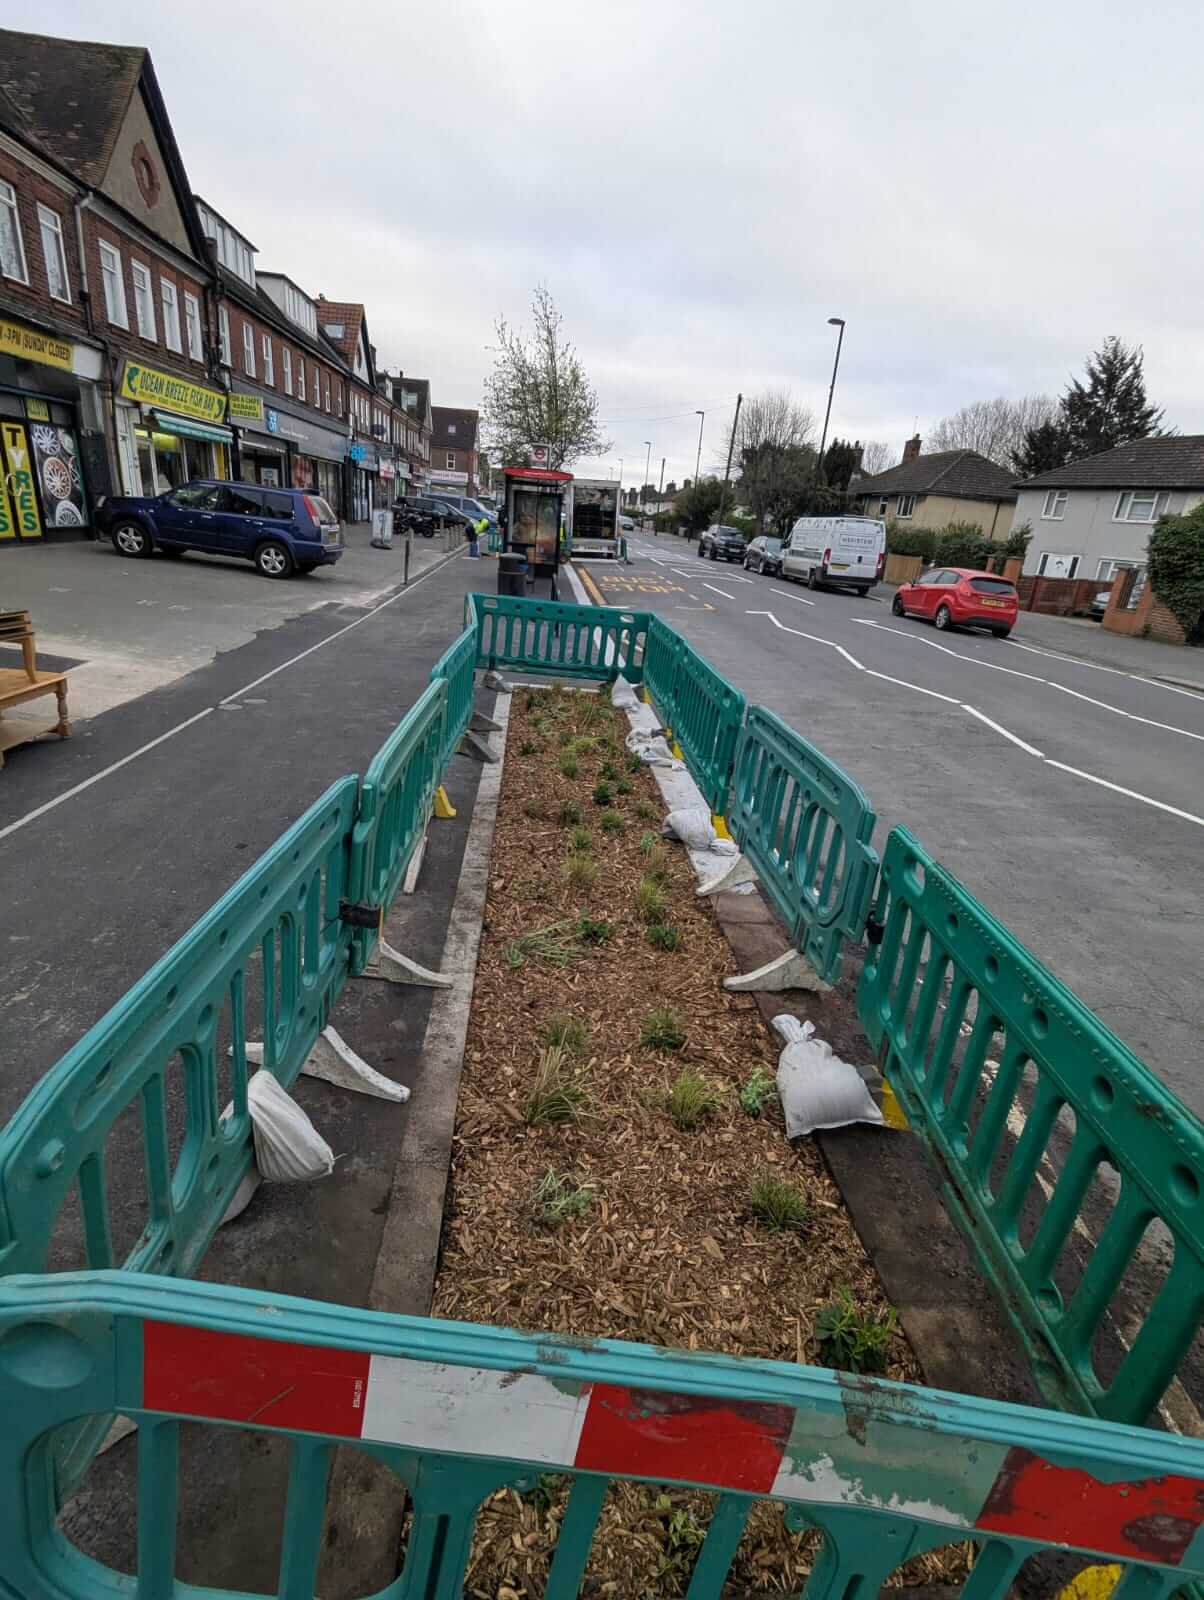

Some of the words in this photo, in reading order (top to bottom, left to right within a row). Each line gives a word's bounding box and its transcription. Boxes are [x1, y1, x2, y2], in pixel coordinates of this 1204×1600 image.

[140, 371, 164, 395] OCEAN
[165, 381, 190, 403] BREEZE
[191, 388, 205, 408] FISH
[205, 393, 215, 411] BAR
[6, 426, 37, 532] TYRES
